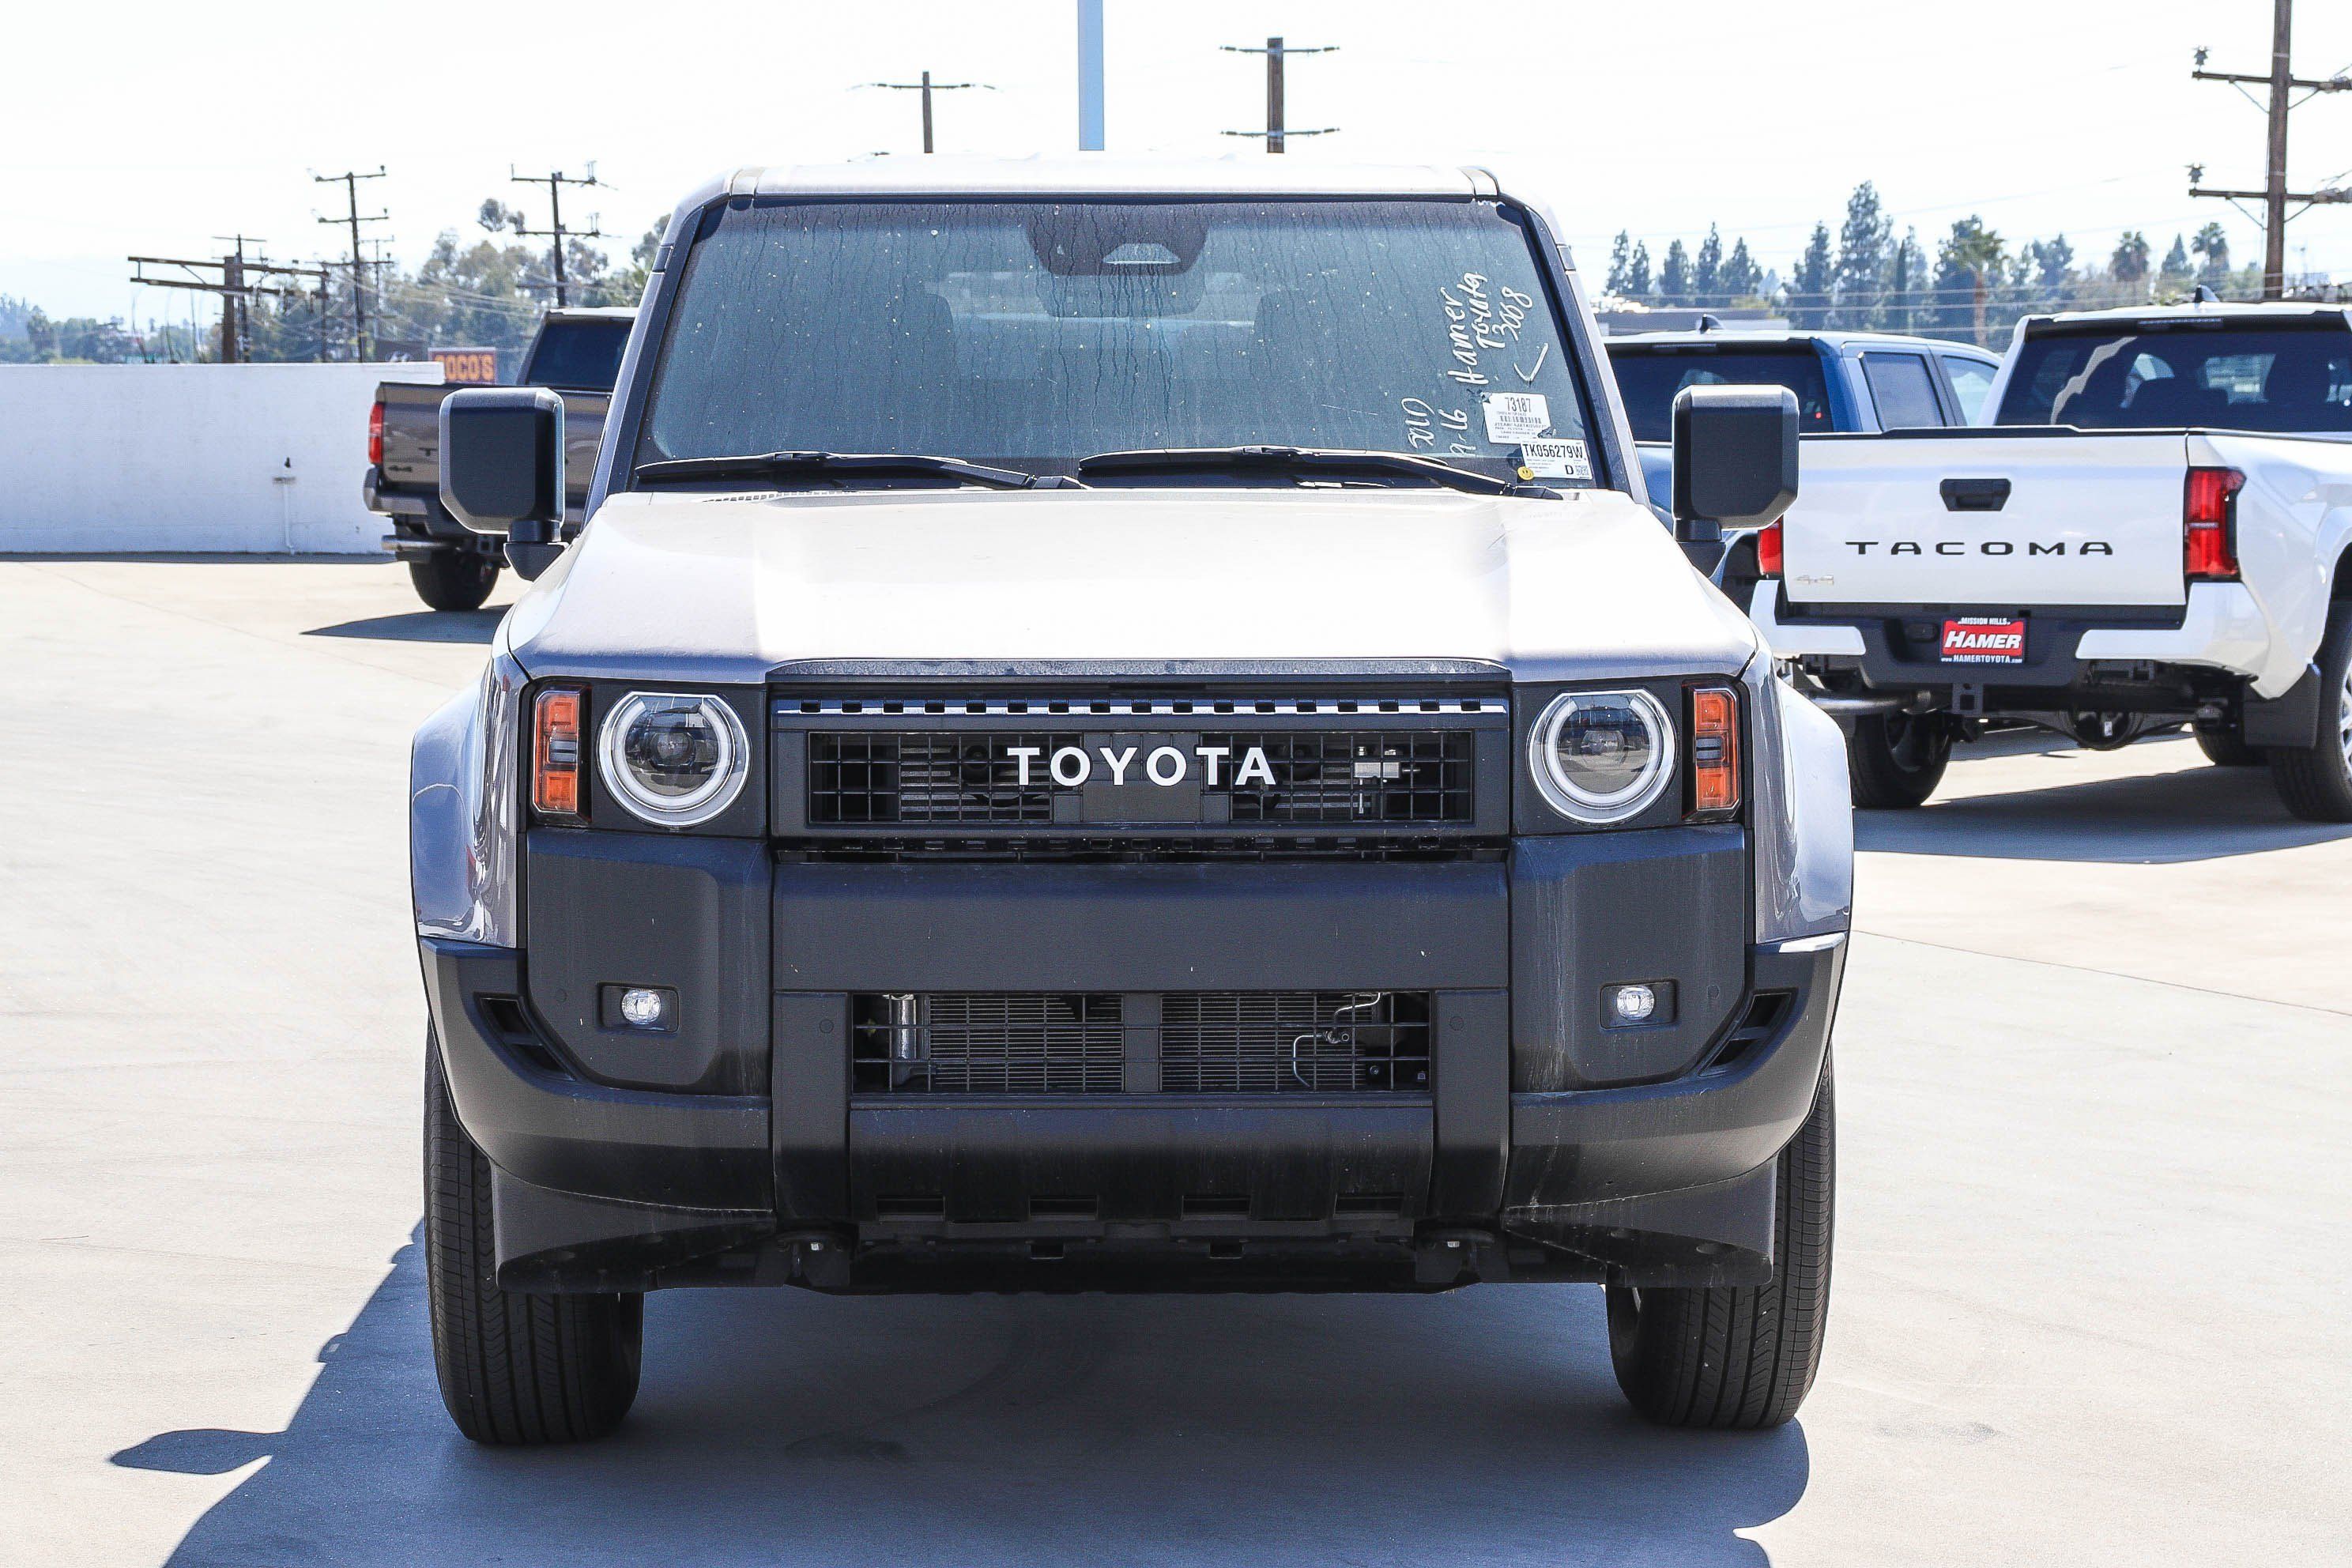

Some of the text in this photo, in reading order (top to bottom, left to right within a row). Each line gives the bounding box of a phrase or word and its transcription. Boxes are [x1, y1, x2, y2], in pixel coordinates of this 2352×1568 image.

[1440, 287, 1489, 385] Hamer
[1505, 398, 1532, 413] 73187
[1522, 444, 1583, 458] TK056279W
[1565, 465, 1574, 475] D
[1845, 541, 2113, 556] TACOMA
[1007, 746, 1276, 787] TOYOTA
